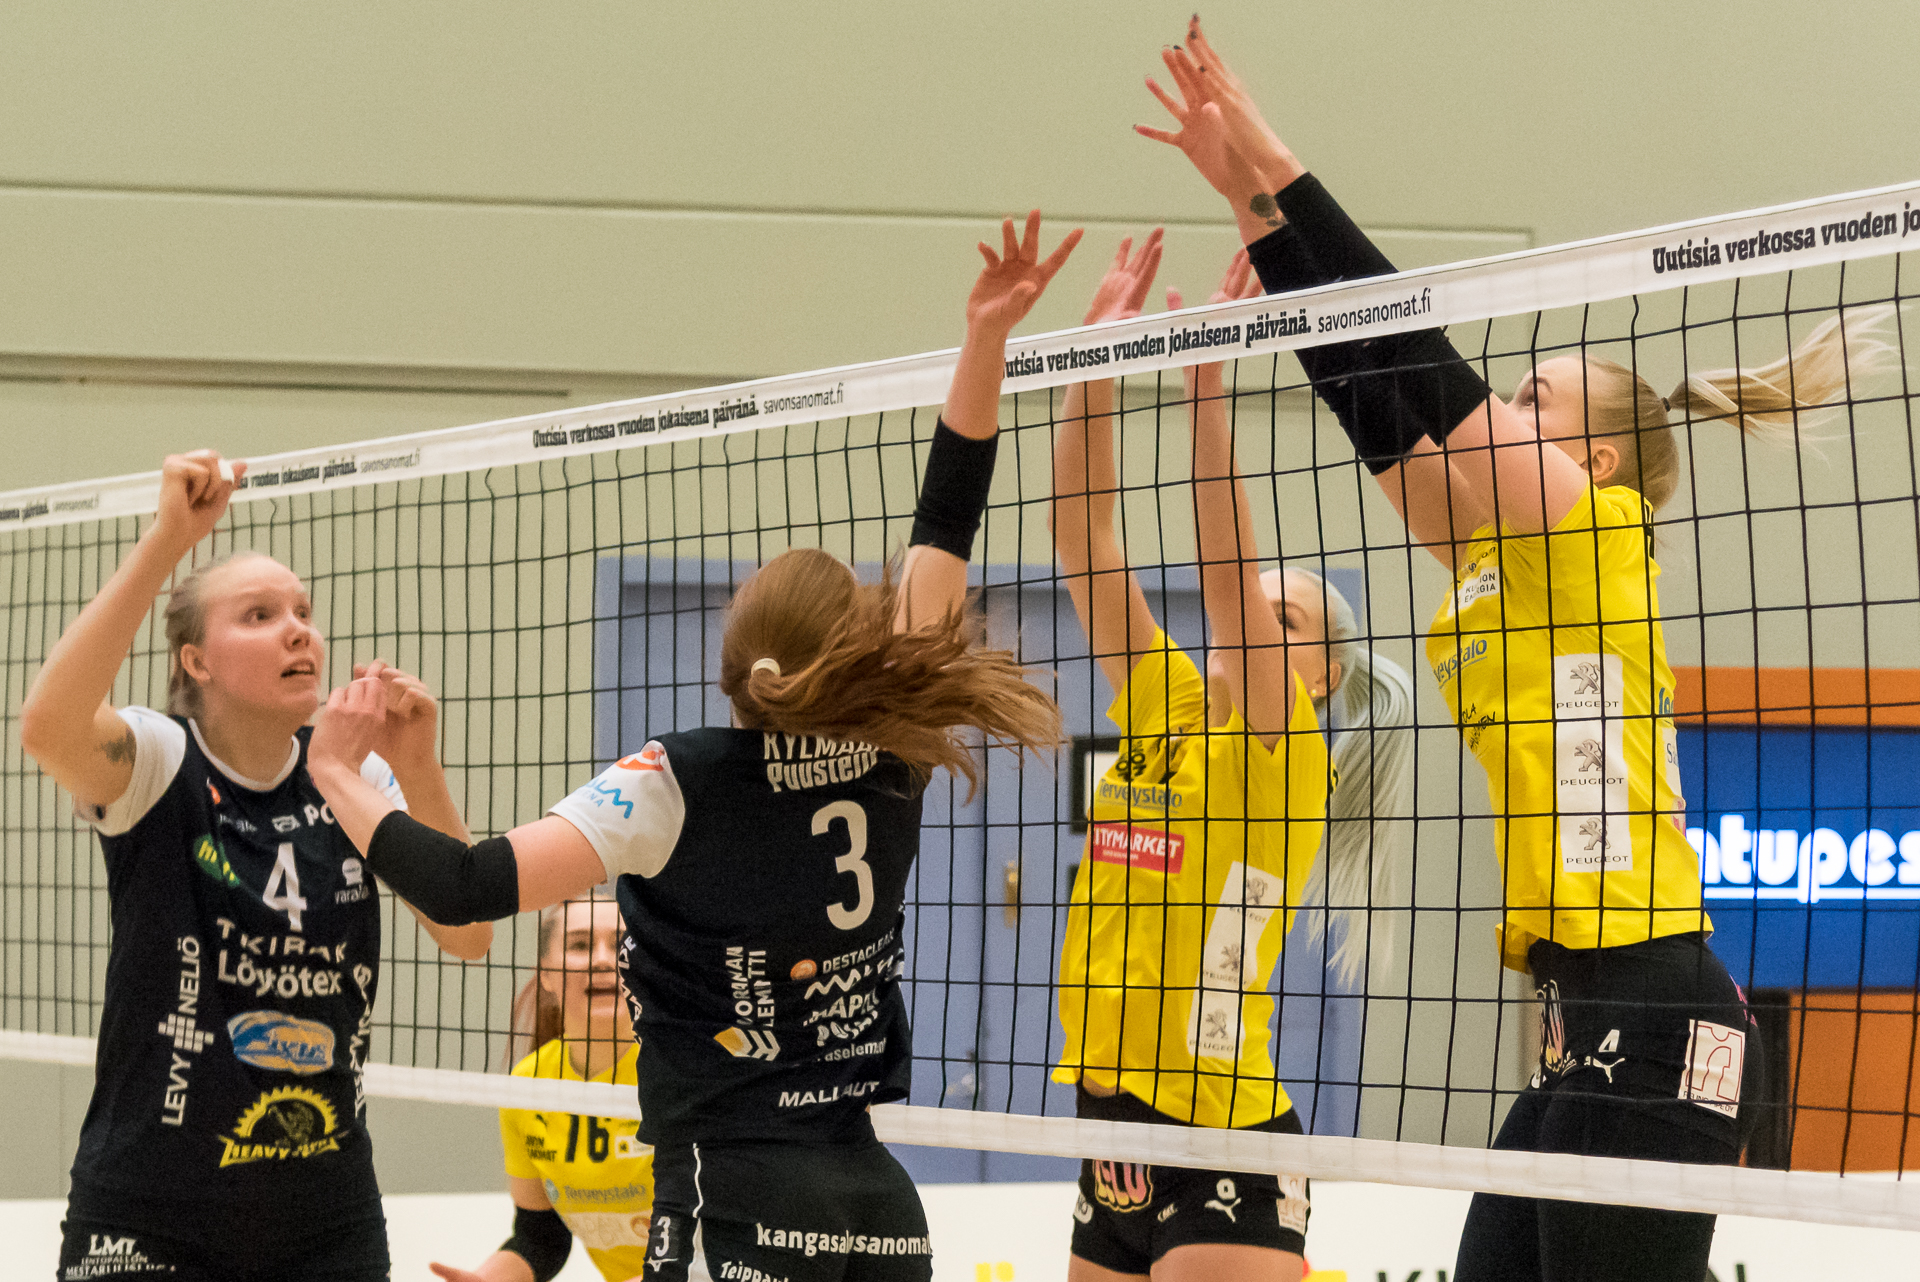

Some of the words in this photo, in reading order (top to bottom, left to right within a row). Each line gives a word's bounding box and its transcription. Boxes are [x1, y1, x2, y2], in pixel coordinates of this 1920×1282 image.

[1652, 237, 1721, 274] Uutisia
[1725, 227, 1816, 263] verkossa
[1821, 211, 1898, 246] vuoden
[1003, 350, 1044, 379] utisia
[1046, 341, 1110, 373] verkossa
[1113, 332, 1165, 362] vuoden
[1168, 321, 1241, 357] jokaisena
[1245, 309, 1312, 349] päivänä.
[1317, 288, 1432, 334] savonsanomat.fi
[533, 425, 568, 449] Uutisia
[570, 423, 616, 444] verkossa
[617, 413, 656, 437] vuoden
[658, 404, 709, 434] jokaisena
[713, 394, 760, 428] päivänä.
[763, 382, 844, 415] savonsanomat.fi
[1556, 700, 1619, 708] PEUGEOT
[1560, 777, 1625, 787] PEUGEOT
[811, 800, 875, 930] 3
[1093, 827, 1182, 859] ITYMARKET
[1566, 855, 1629, 865] PEUGEOT
[262, 842, 308, 933] 4
[177, 935, 200, 1016] NELIÖ
[161, 1051, 191, 1126] LEVY
[655, 1215, 672, 1257] 3
